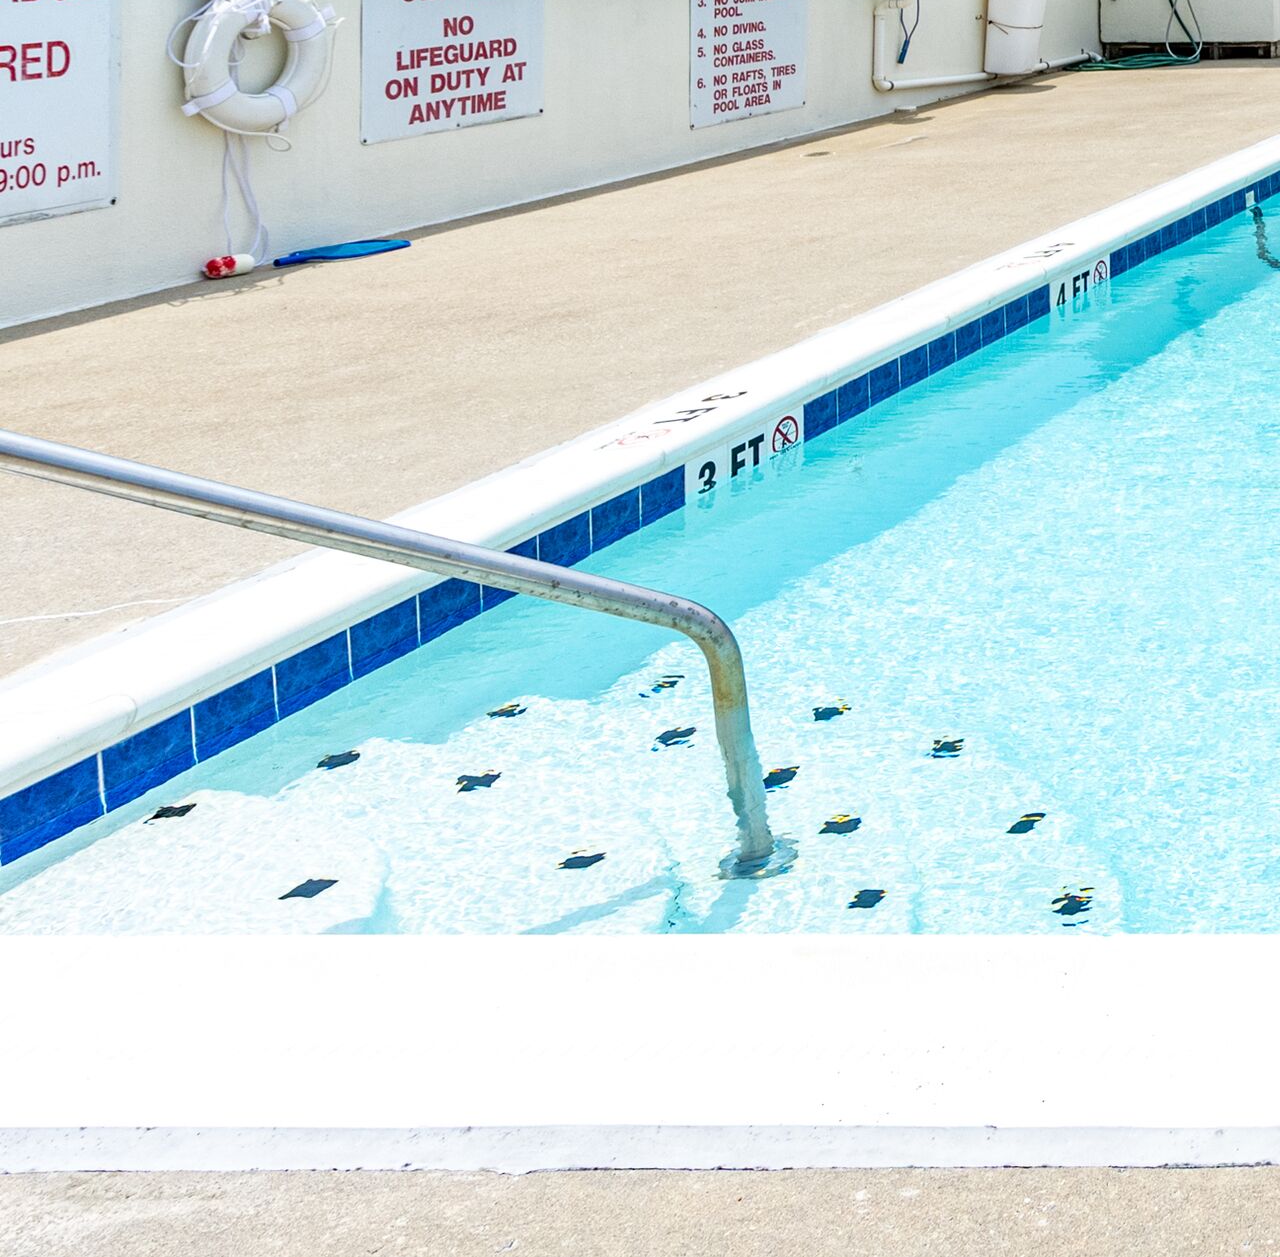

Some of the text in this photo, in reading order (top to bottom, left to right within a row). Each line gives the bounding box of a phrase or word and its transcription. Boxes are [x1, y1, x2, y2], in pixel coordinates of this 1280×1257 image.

[714, 6, 743, 19] POOL.
[442, 15, 475, 38] NO
[697, 21, 767, 39] 4. NO DIVING.
[395, 37, 518, 72] LIFEGUARD
[697, 39, 764, 58] 5. NO GLASS
[713, 50, 776, 68] CONTAINERS.
[385, 61, 528, 101] ON DUTY AT
[697, 64, 796, 89] 6. NO RAFTS, TIRES
[713, 78, 783, 102] OR FLOATS IN
[408, 90, 507, 125] ANYTIME
[713, 93, 772, 114] POOL AREA
[57, 161, 101, 188] p.m.
[1056, 270, 1090, 306] 4 FT
[698, 460, 716, 494] 3
[730, 433, 764, 479] FT
